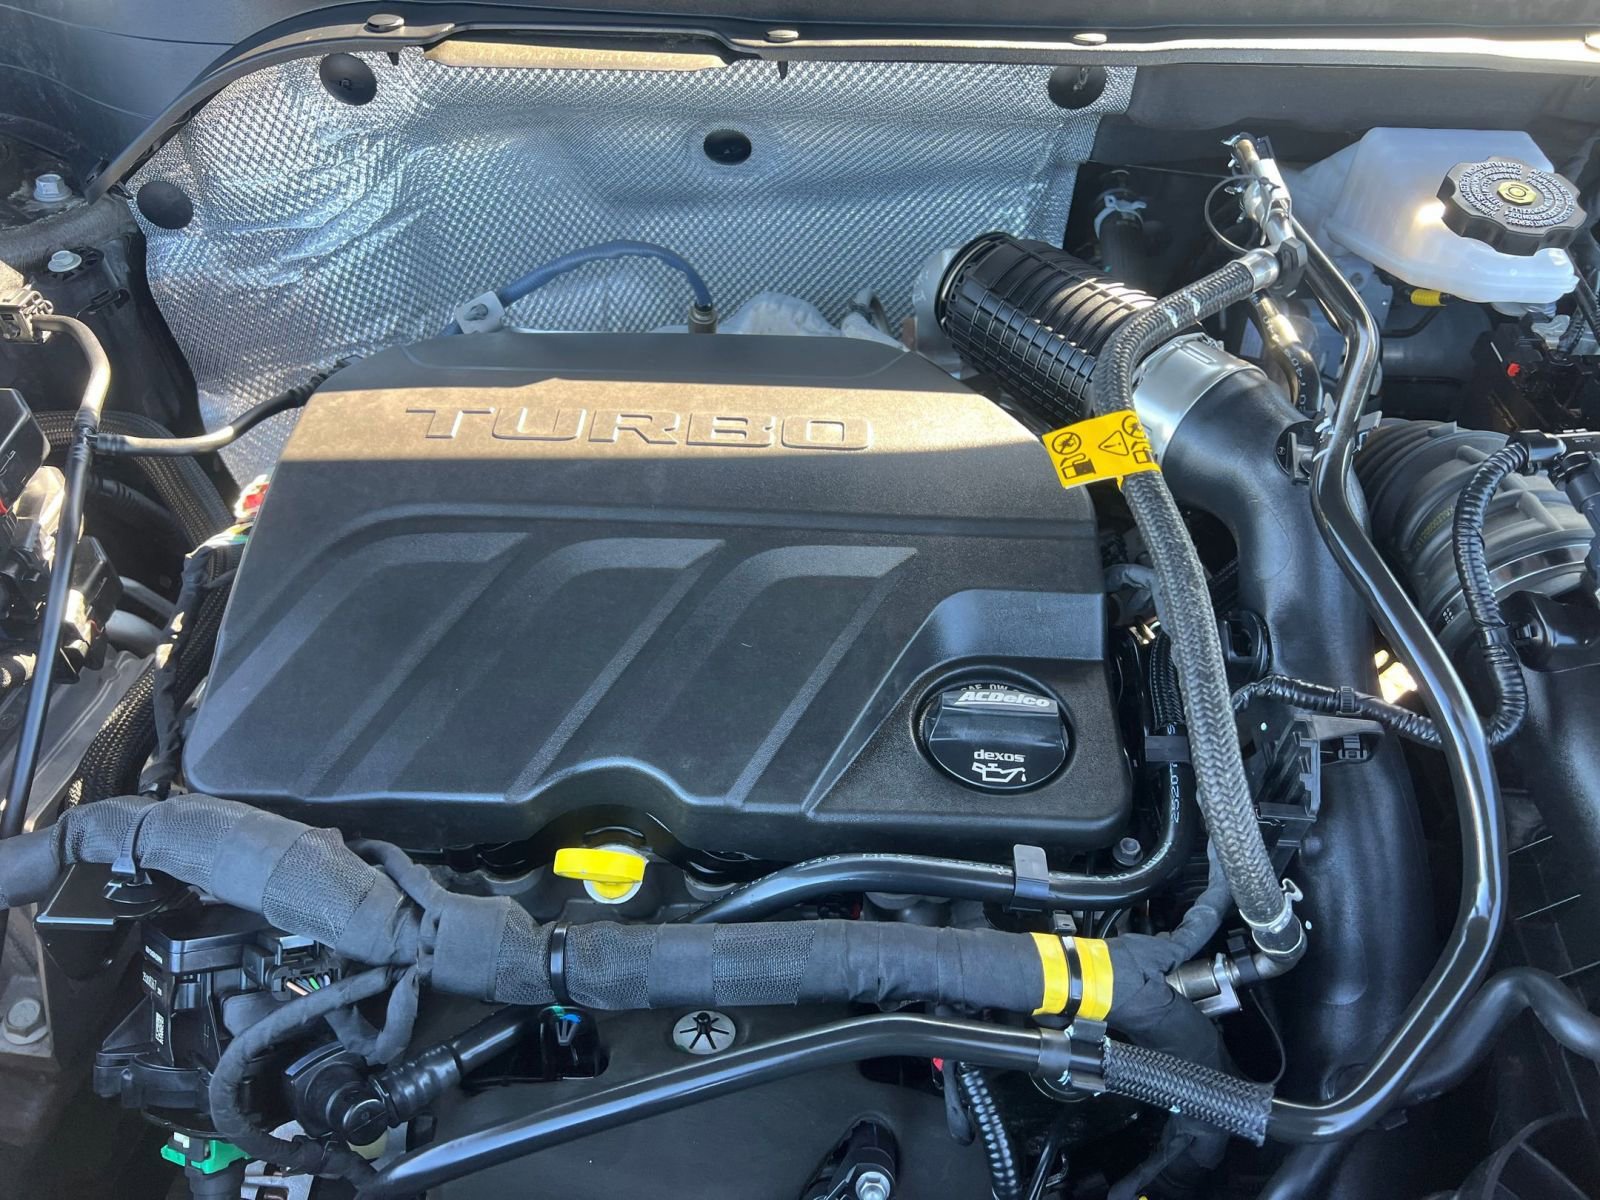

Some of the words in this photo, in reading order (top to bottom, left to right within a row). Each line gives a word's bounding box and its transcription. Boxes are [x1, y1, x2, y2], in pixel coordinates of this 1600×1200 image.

[405, 406, 876, 451] TURBO
[957, 691, 1050, 707] ACDelco
[974, 749, 1026, 763] dexos
